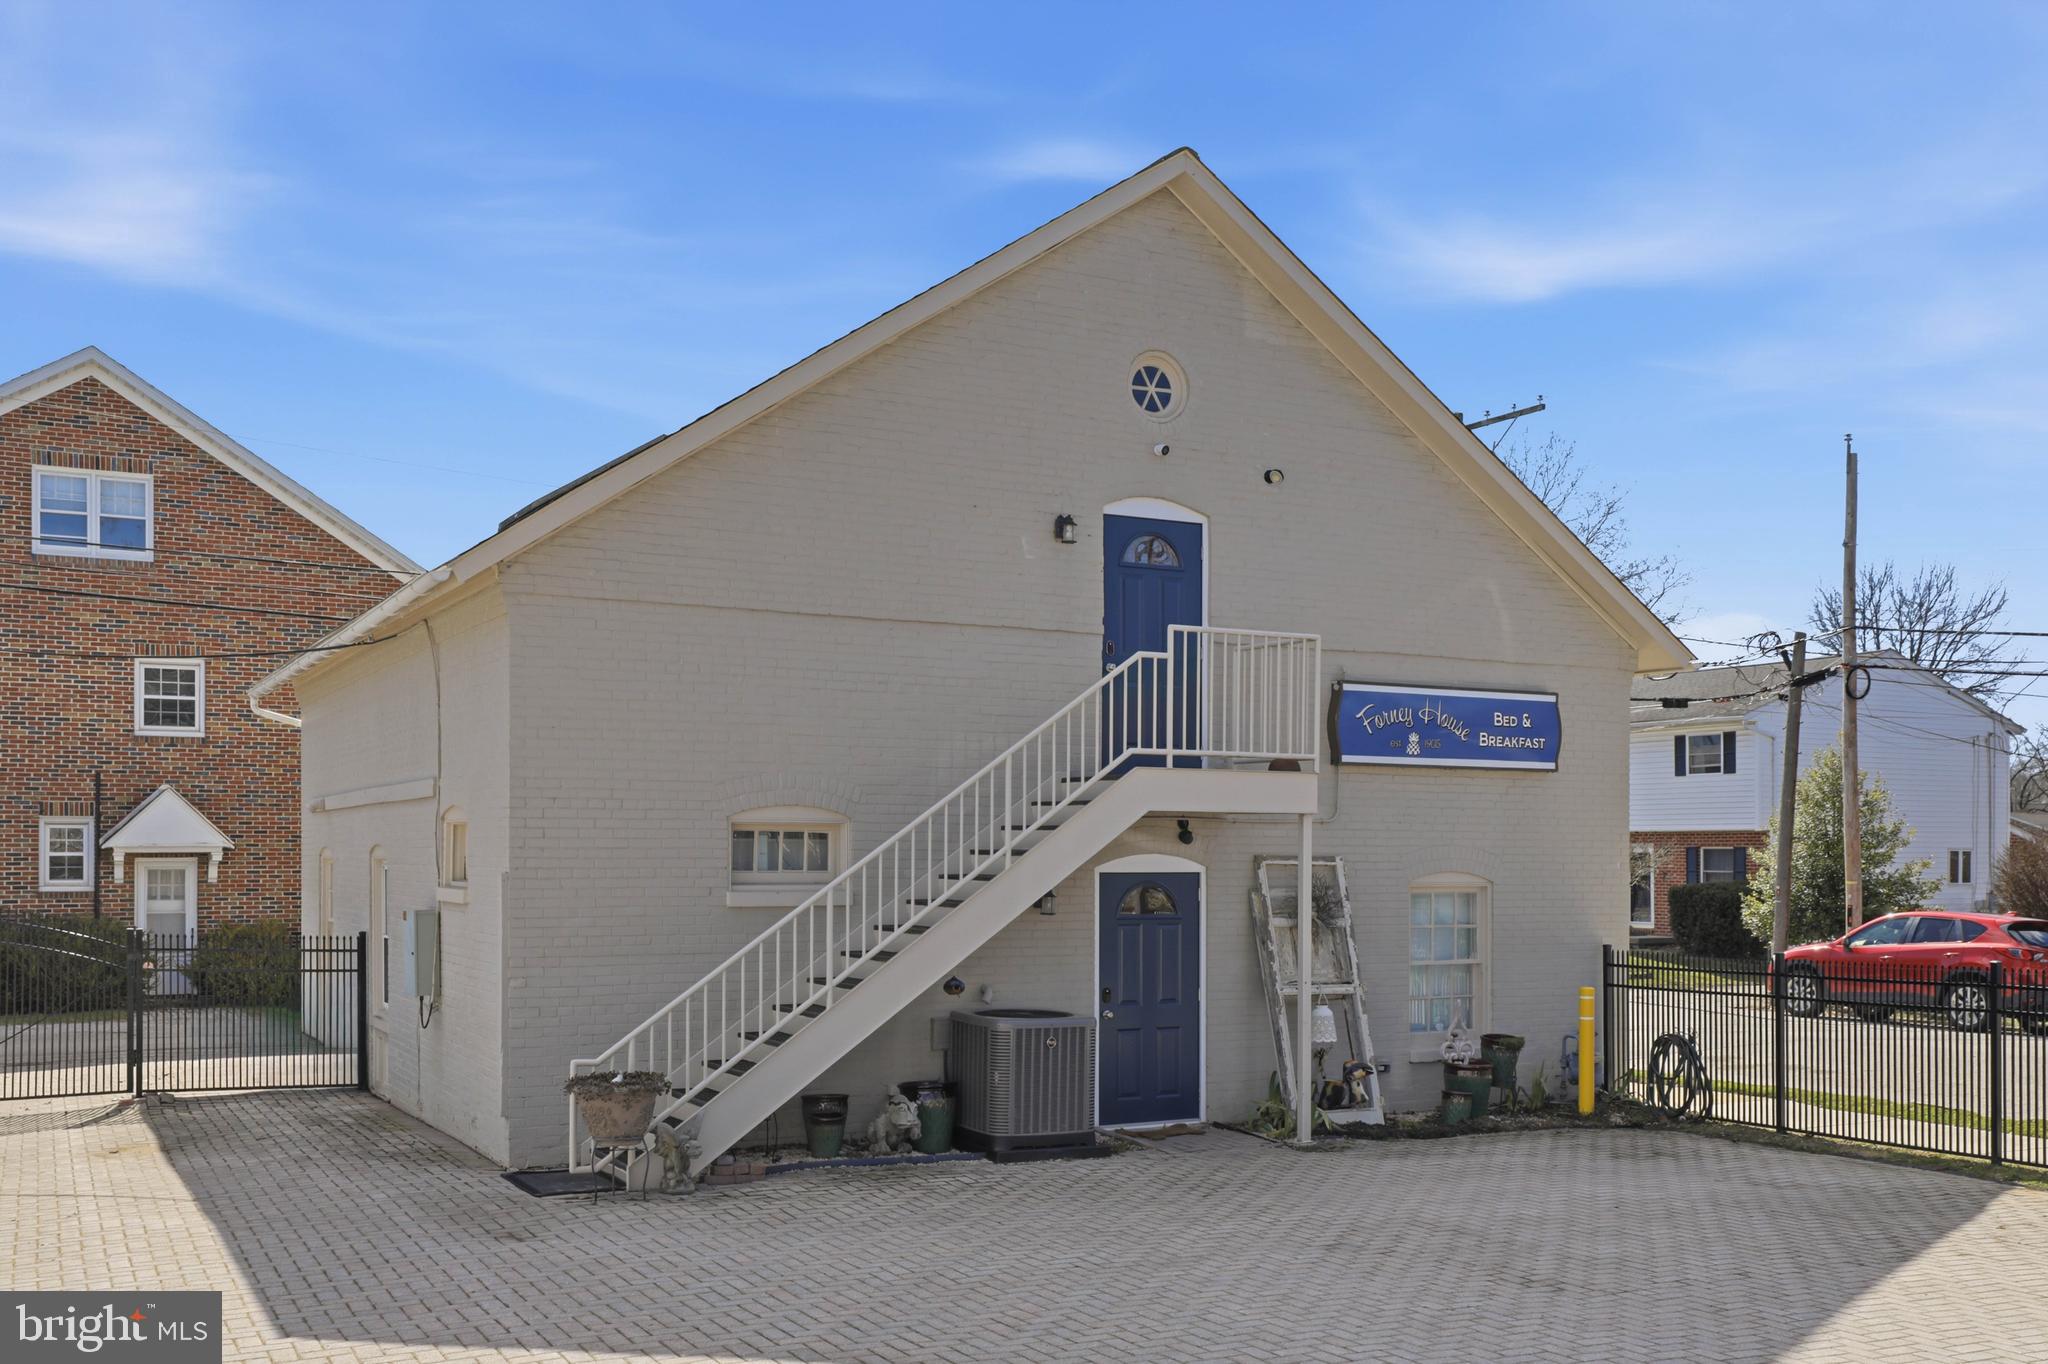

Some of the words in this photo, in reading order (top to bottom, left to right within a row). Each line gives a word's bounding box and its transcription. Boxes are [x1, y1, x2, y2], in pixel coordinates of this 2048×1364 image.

[1355, 703, 1413, 734] Forney
[1419, 697, 1471, 741] House
[1522, 713, 1532, 728] &
